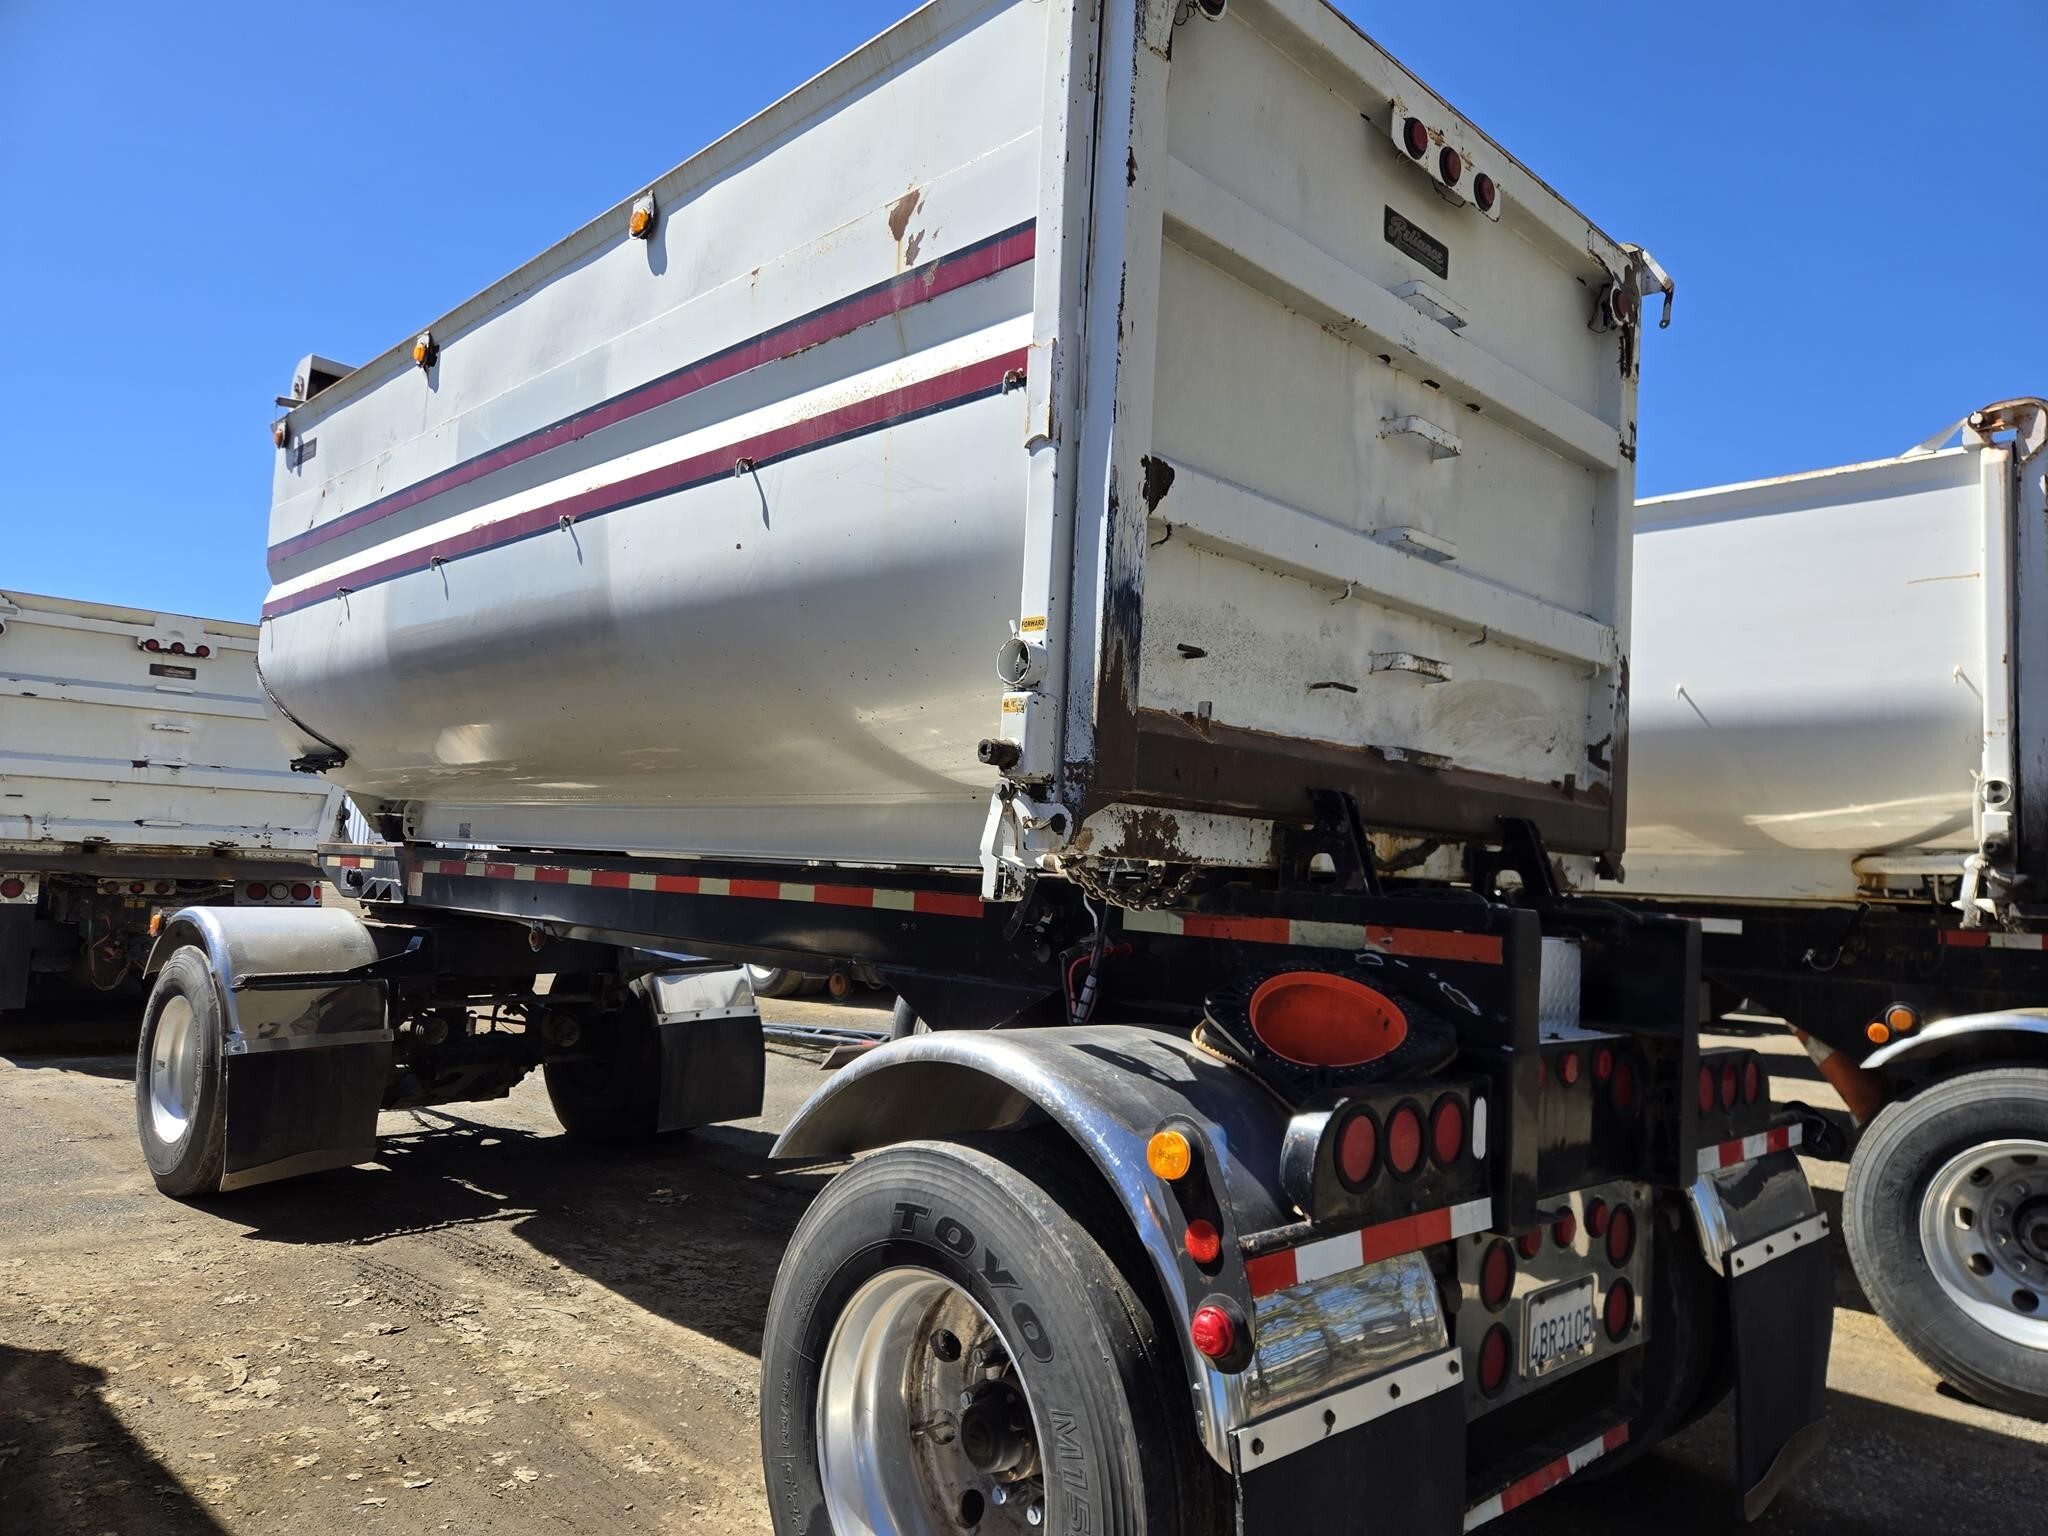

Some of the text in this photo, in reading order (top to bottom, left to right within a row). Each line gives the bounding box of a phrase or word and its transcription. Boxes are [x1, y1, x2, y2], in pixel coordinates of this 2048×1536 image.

[1388, 215, 1444, 265] Reliance
[1021, 619, 1045, 629] FORWARD
[893, 1202, 1055, 1363] TOYO
[1531, 1305, 1591, 1361] 4BR3105
[1049, 1408, 1091, 1536] M15
